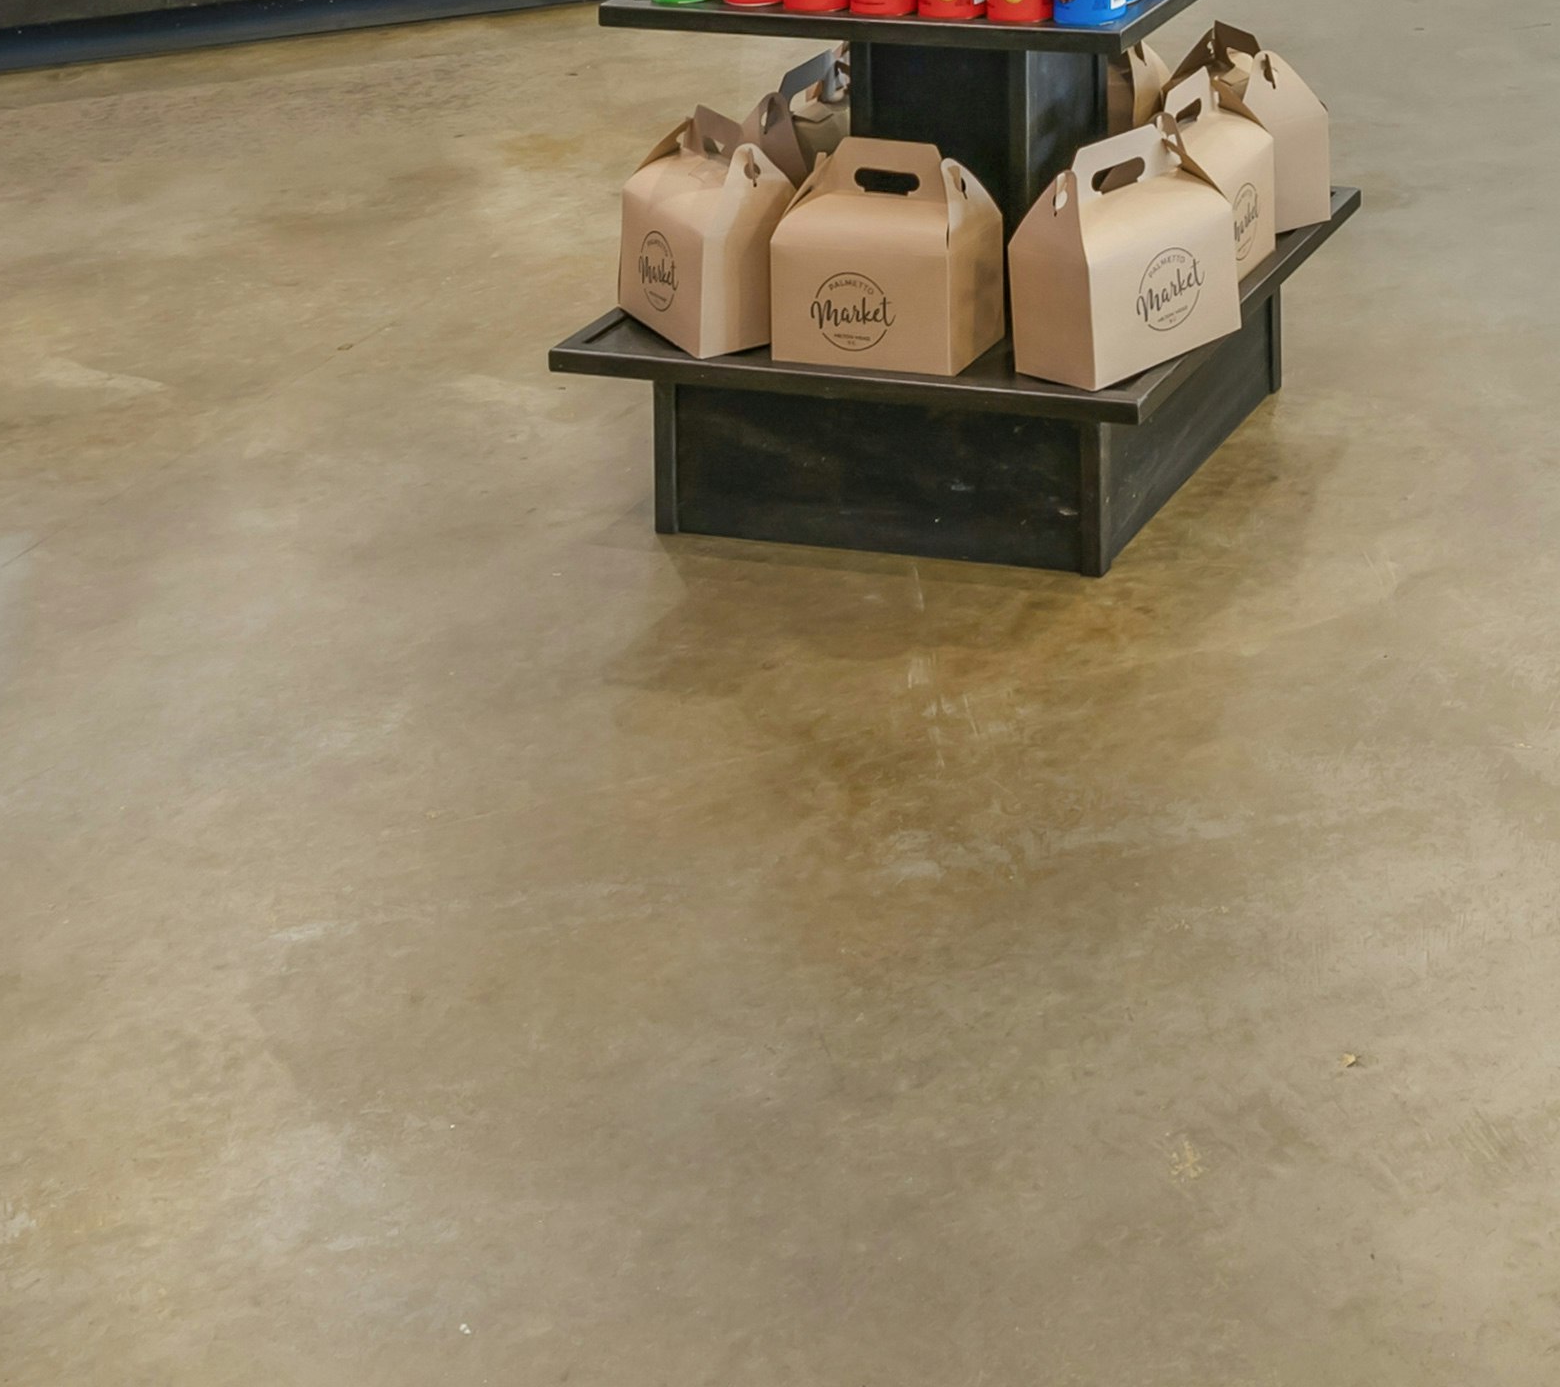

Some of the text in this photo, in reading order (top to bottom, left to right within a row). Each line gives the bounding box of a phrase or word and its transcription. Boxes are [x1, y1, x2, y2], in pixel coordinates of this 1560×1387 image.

[828, 279, 874, 295] PALMETTO
[1136, 257, 1205, 322] Market
[810, 296, 896, 330] Market
